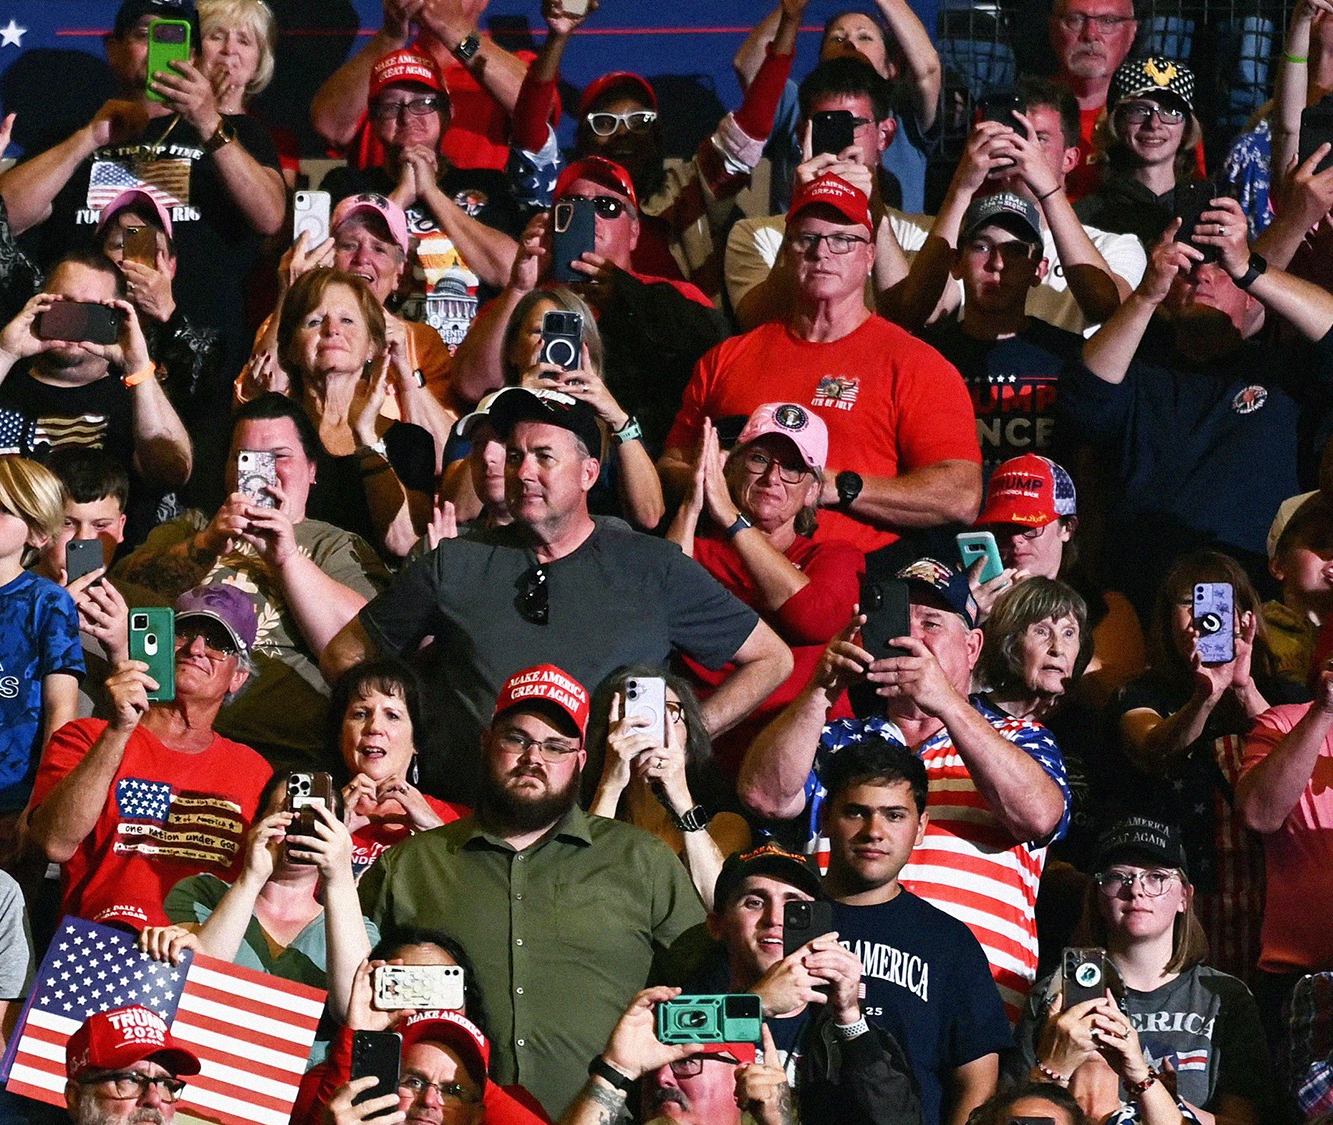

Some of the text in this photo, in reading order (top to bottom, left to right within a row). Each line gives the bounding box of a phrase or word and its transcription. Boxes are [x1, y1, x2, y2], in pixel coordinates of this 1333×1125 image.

[405, 66, 432, 79] AGAIN
[169, 144, 204, 160] TIME
[819, 180, 855, 197] AMERICA
[172, 206, 201, 222] RIG
[824, 399, 834, 407] OF
[835, 400, 854, 411] JULY
[976, 417, 1054, 447] NCE
[508, 670, 586, 703] MAKE AMERICA
[511, 685, 580, 712] GREAT AGAIN
[196, 815, 226, 828] America
[1126, 816, 1170, 835] AMERICA
[125, 825, 237, 851] one nation under God
[1133, 831, 1166, 849] AGAIN
[850, 939, 929, 1002] AMERICA
[107, 1010, 168, 1034] TRUMP
[406, 1011, 485, 1048] MAKE AMERICA
[1131, 1012, 1216, 1039] ERICA
[123, 1027, 165, 1042] 2028
